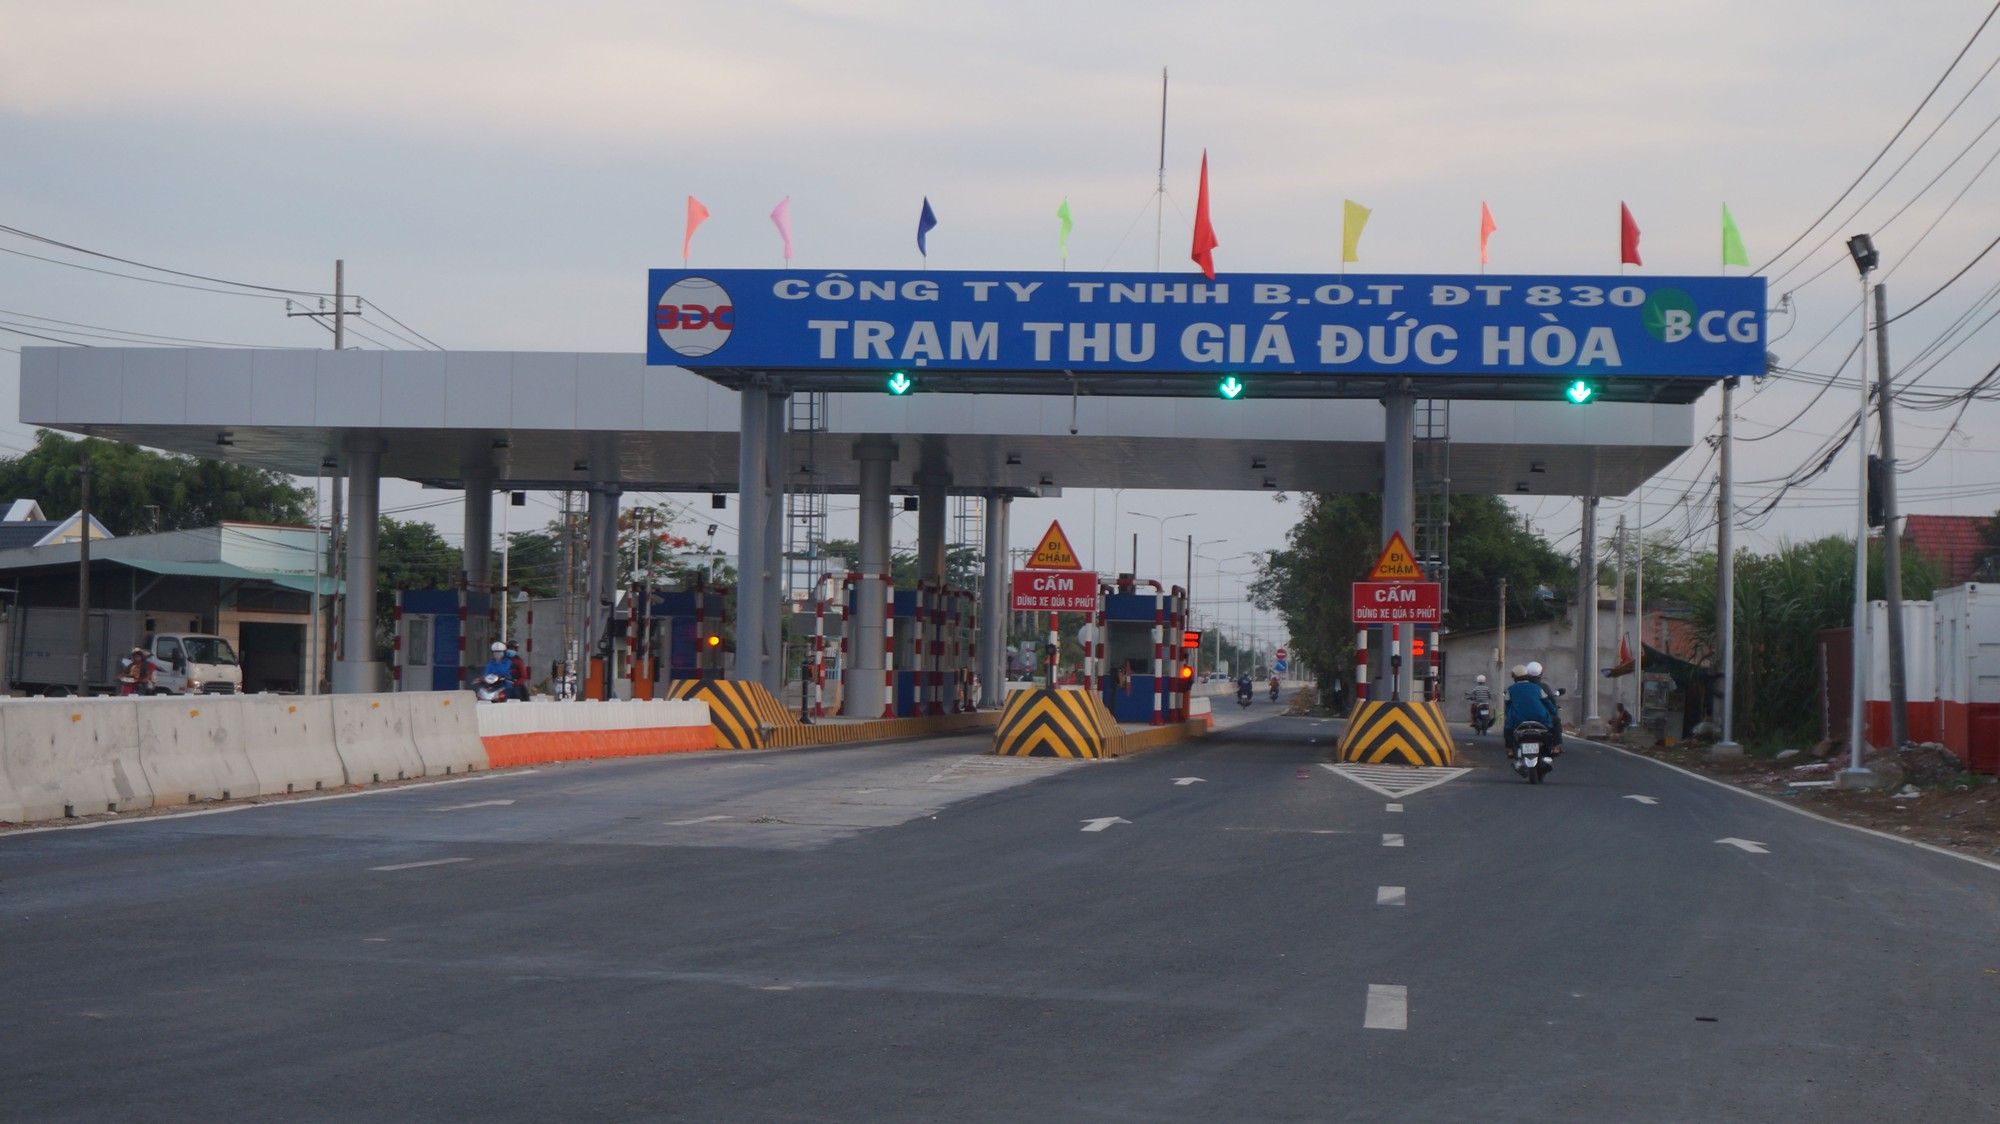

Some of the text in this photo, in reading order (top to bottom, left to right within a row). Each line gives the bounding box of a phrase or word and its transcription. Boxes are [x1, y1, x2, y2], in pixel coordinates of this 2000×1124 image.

[773, 273, 1646, 307] CÔNG TY TNHH B.O.T ĐT 830
[656, 303, 735, 331] BDC
[1665, 309, 1758, 343] BCG
[808, 311, 1622, 367] TRẠM THU GIÁ ĐỨC HÒA
[1048, 542, 1061, 550] ĐI
[1037, 552, 1070, 564] CHẬM
[1391, 553, 1404, 562] ĐI
[1033, 574, 1073, 591] CẤM
[1039, 596, 1049, 607] XE
[1068, 597, 1073, 607] 5
[1075, 595, 1095, 608] PHÚT
[1375, 585, 1417, 602] CẤM
[1380, 608, 1390, 619] XE
[1409, 608, 1415, 619] 5
[1416, 605, 1437, 619] PHÚT
